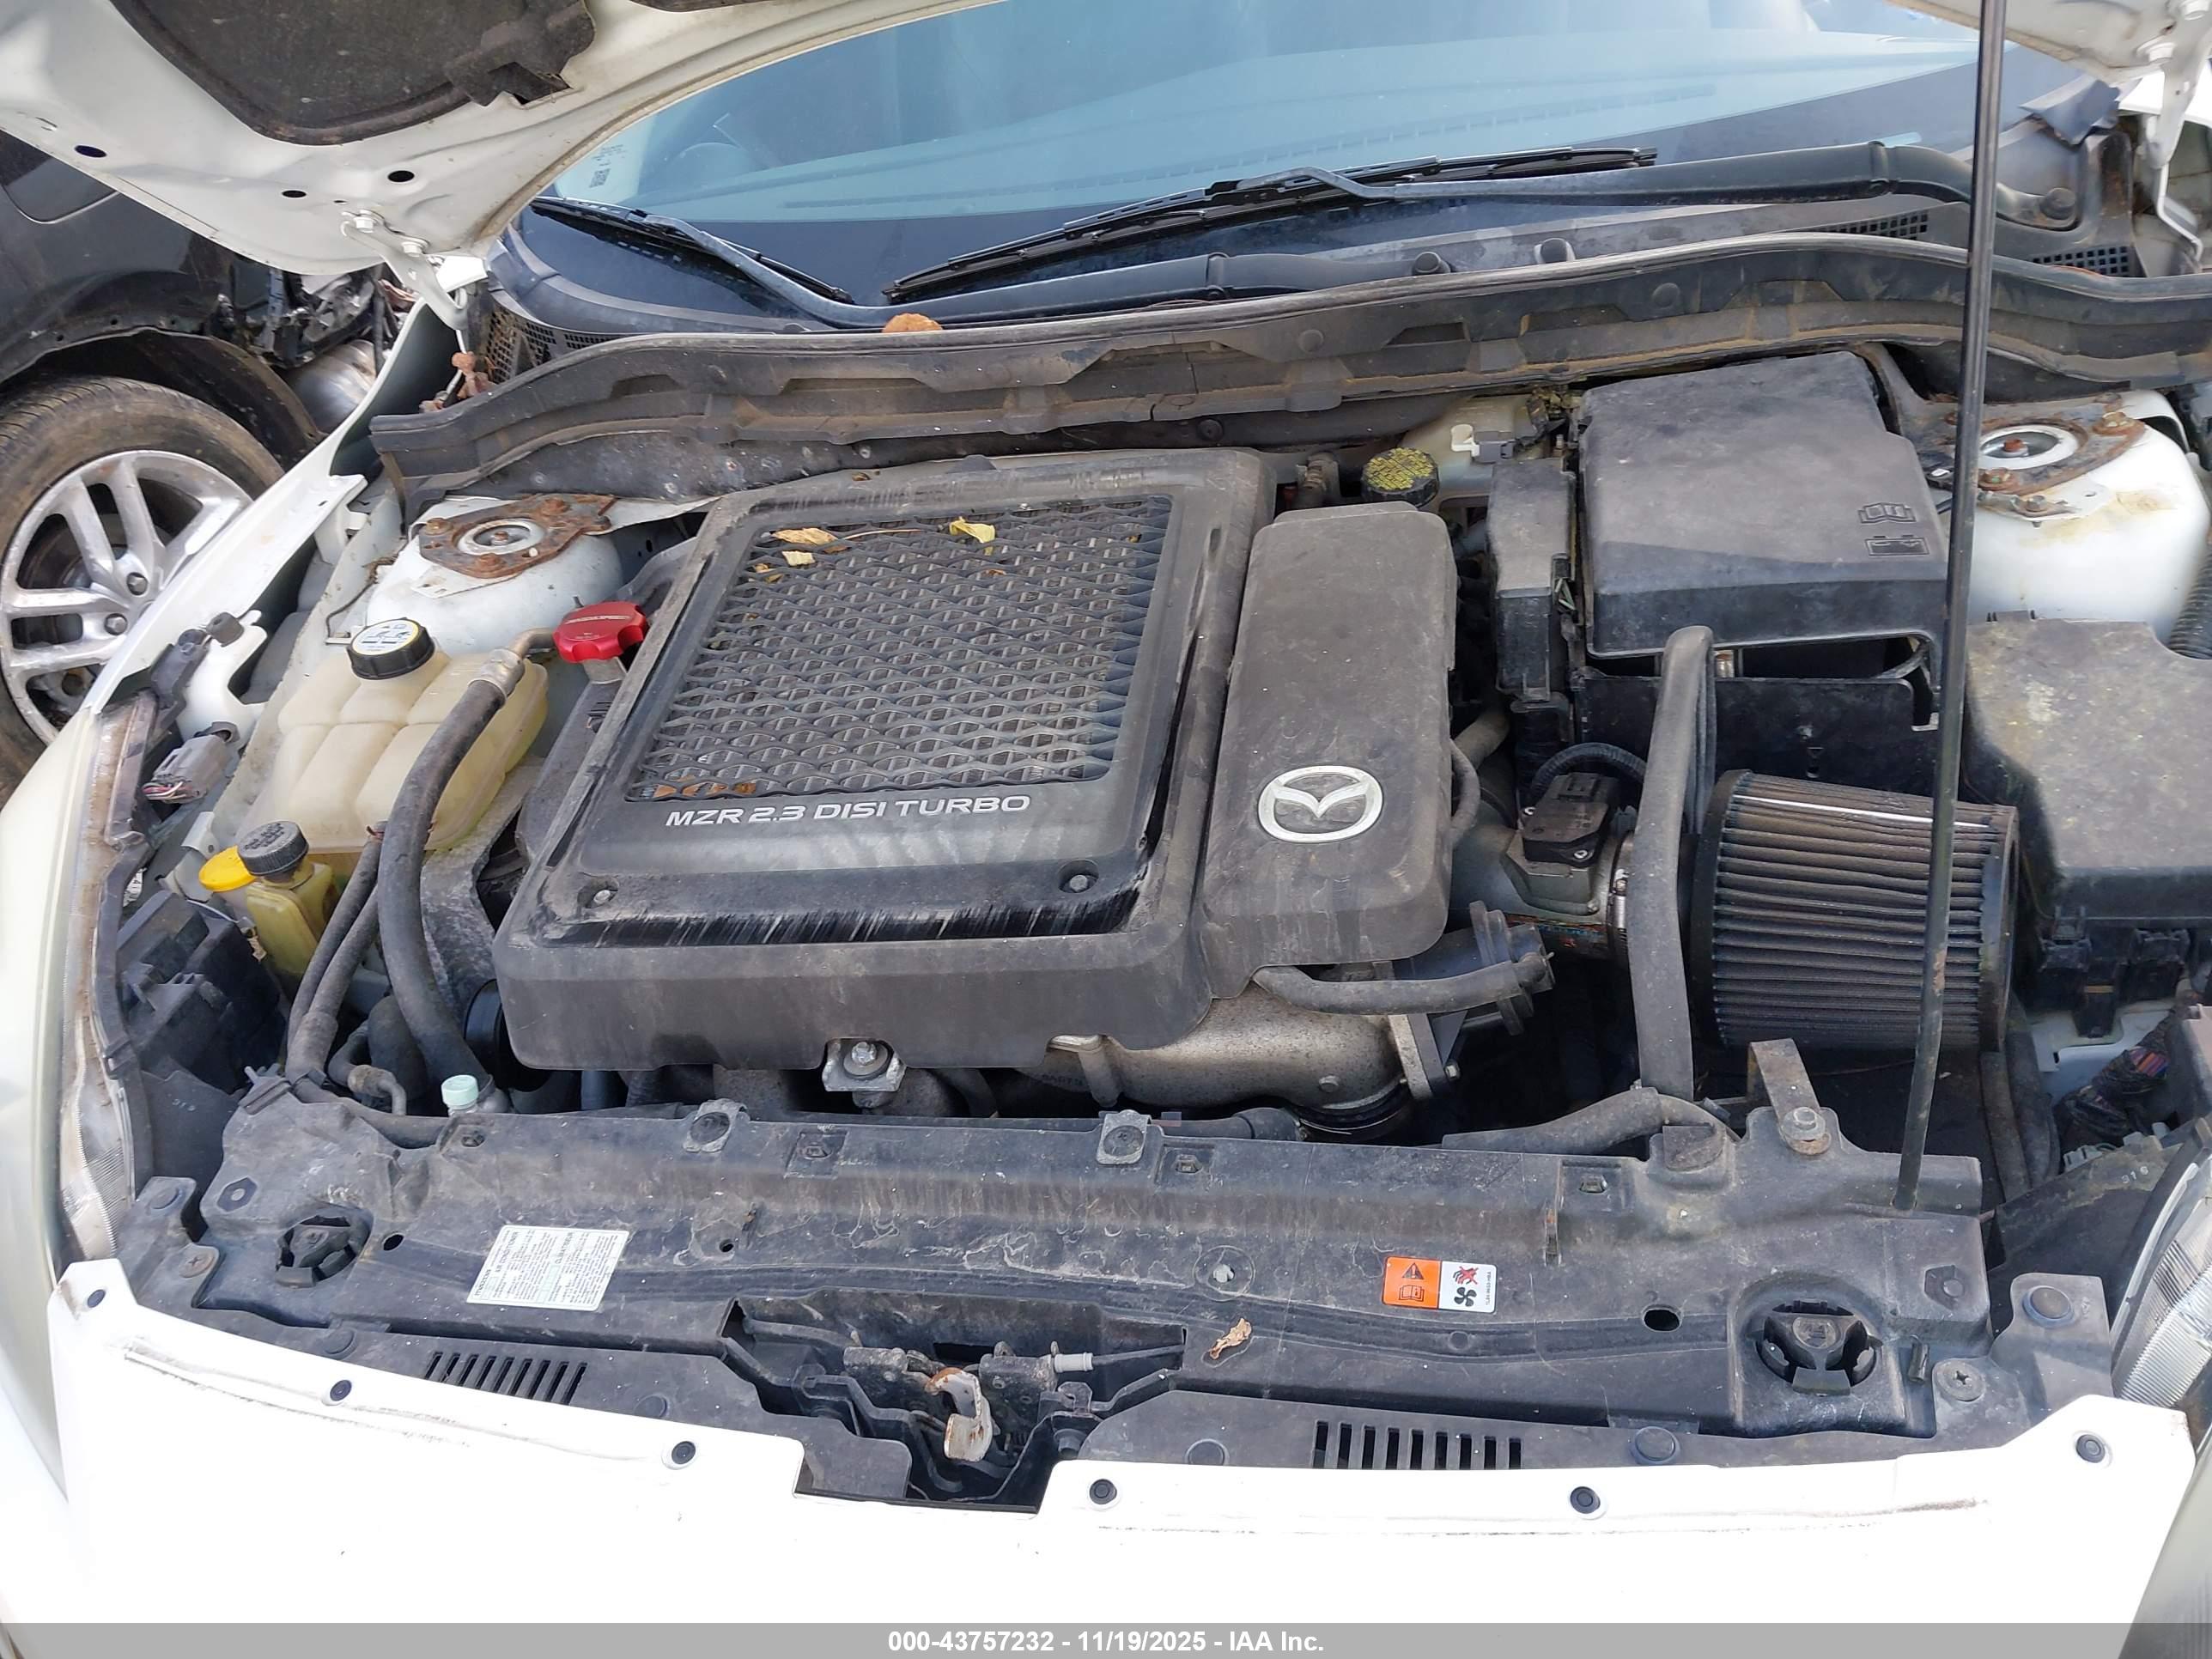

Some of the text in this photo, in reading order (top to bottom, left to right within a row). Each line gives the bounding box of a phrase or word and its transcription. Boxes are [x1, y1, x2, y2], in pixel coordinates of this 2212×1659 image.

[665, 795, 1031, 826] MZR 2.3 DISI TURBO
